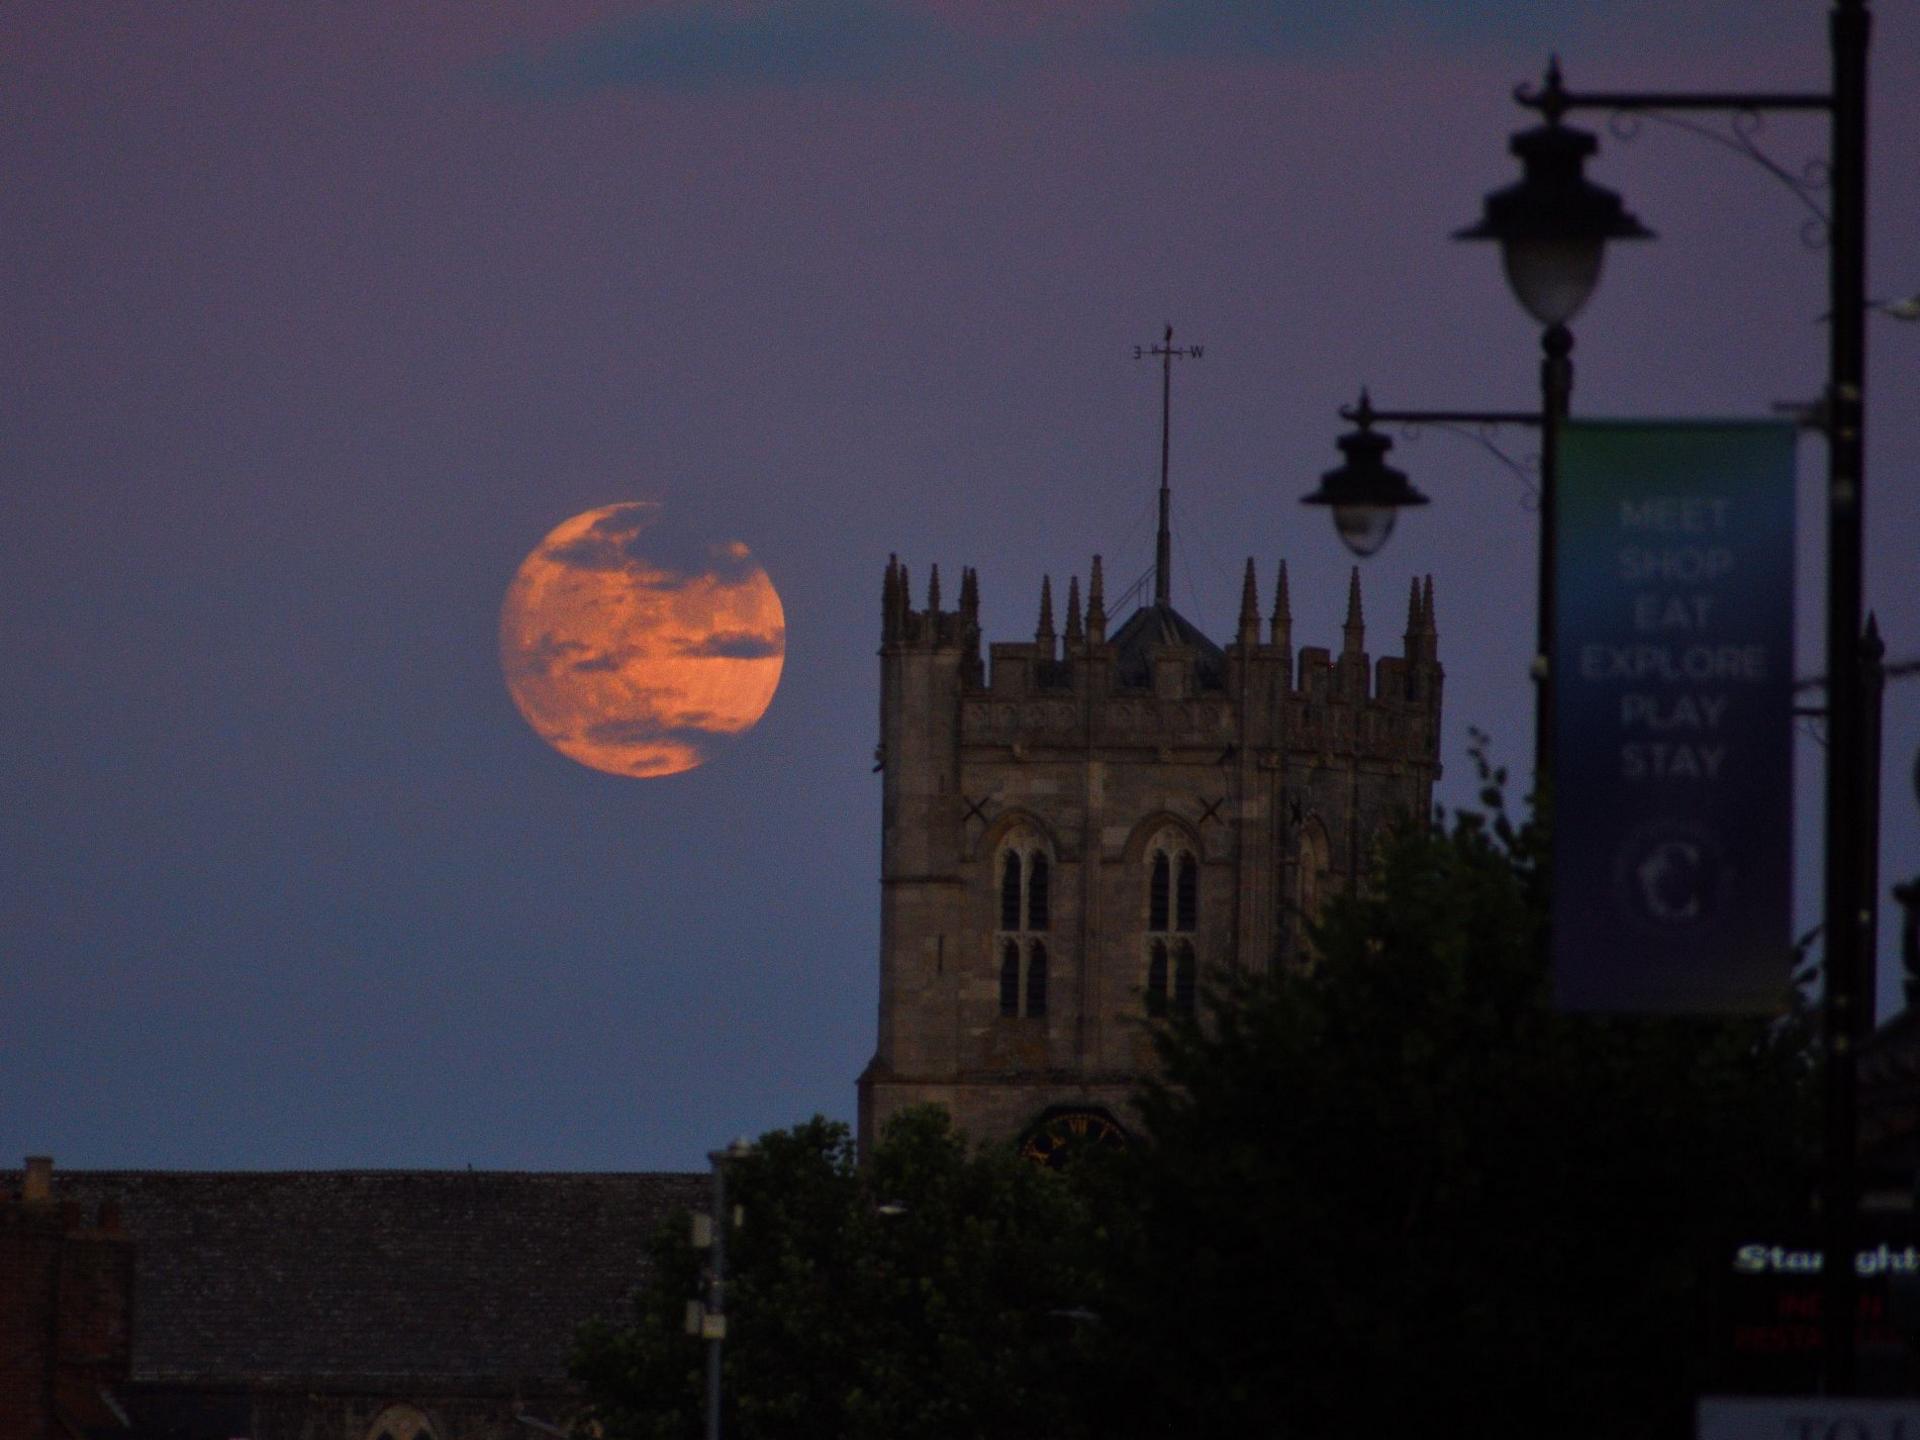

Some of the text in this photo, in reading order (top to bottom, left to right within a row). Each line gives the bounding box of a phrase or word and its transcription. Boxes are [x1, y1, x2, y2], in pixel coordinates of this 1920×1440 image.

[1620, 497, 1727, 530] MEET
[1618, 547, 1733, 580] SHOP
[1634, 594, 1712, 629] EAT
[1580, 645, 1767, 679] EXPLORE
[1620, 694, 1728, 728] PLAY
[1621, 742, 1726, 777] STAY
